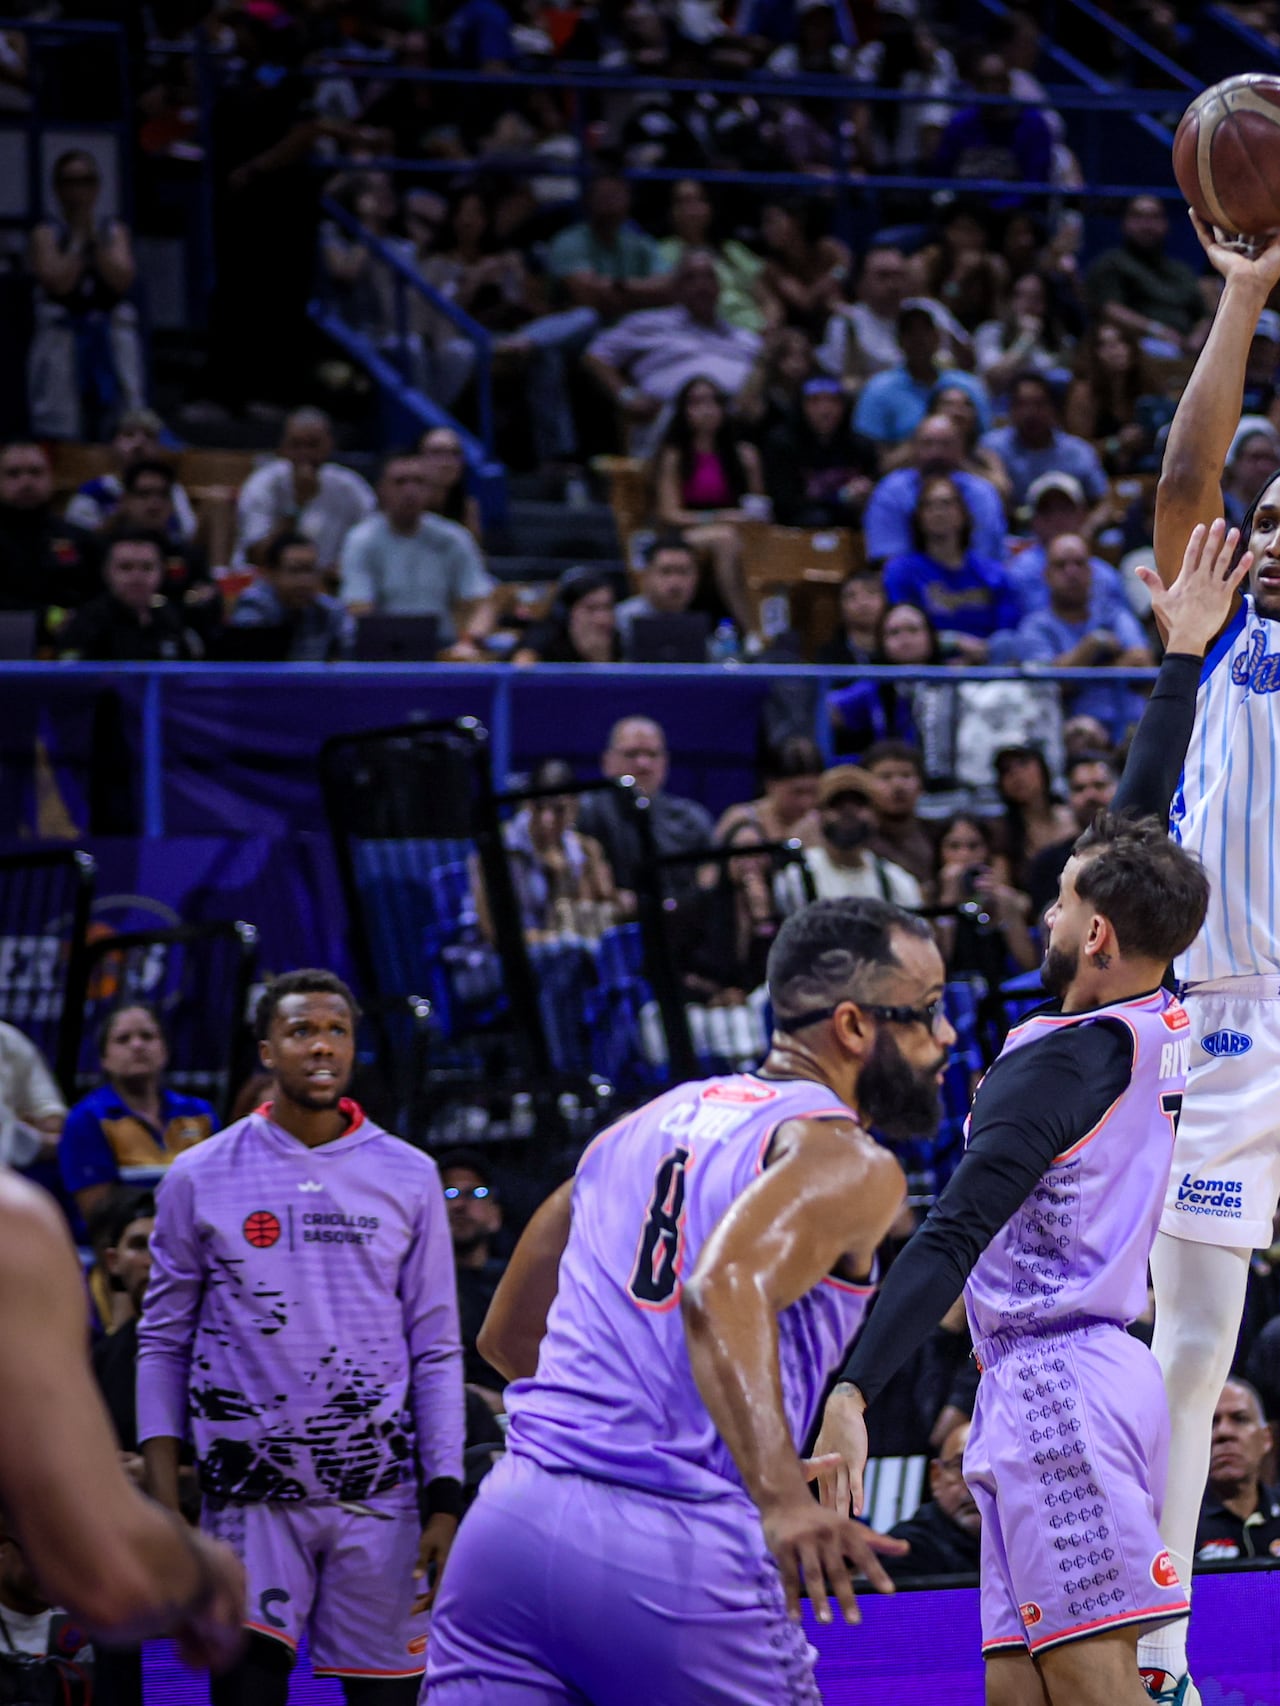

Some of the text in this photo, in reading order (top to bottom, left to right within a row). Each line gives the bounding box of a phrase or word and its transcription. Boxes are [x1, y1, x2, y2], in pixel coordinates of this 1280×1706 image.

[1181, 1172, 1243, 1193] Lomas
[1178, 1186, 1242, 1208] Verdes
[1174, 1201, 1242, 1218] Cooperativa
[302, 1212, 379, 1229] CRIOLLOS
[628, 1144, 693, 1310] 8
